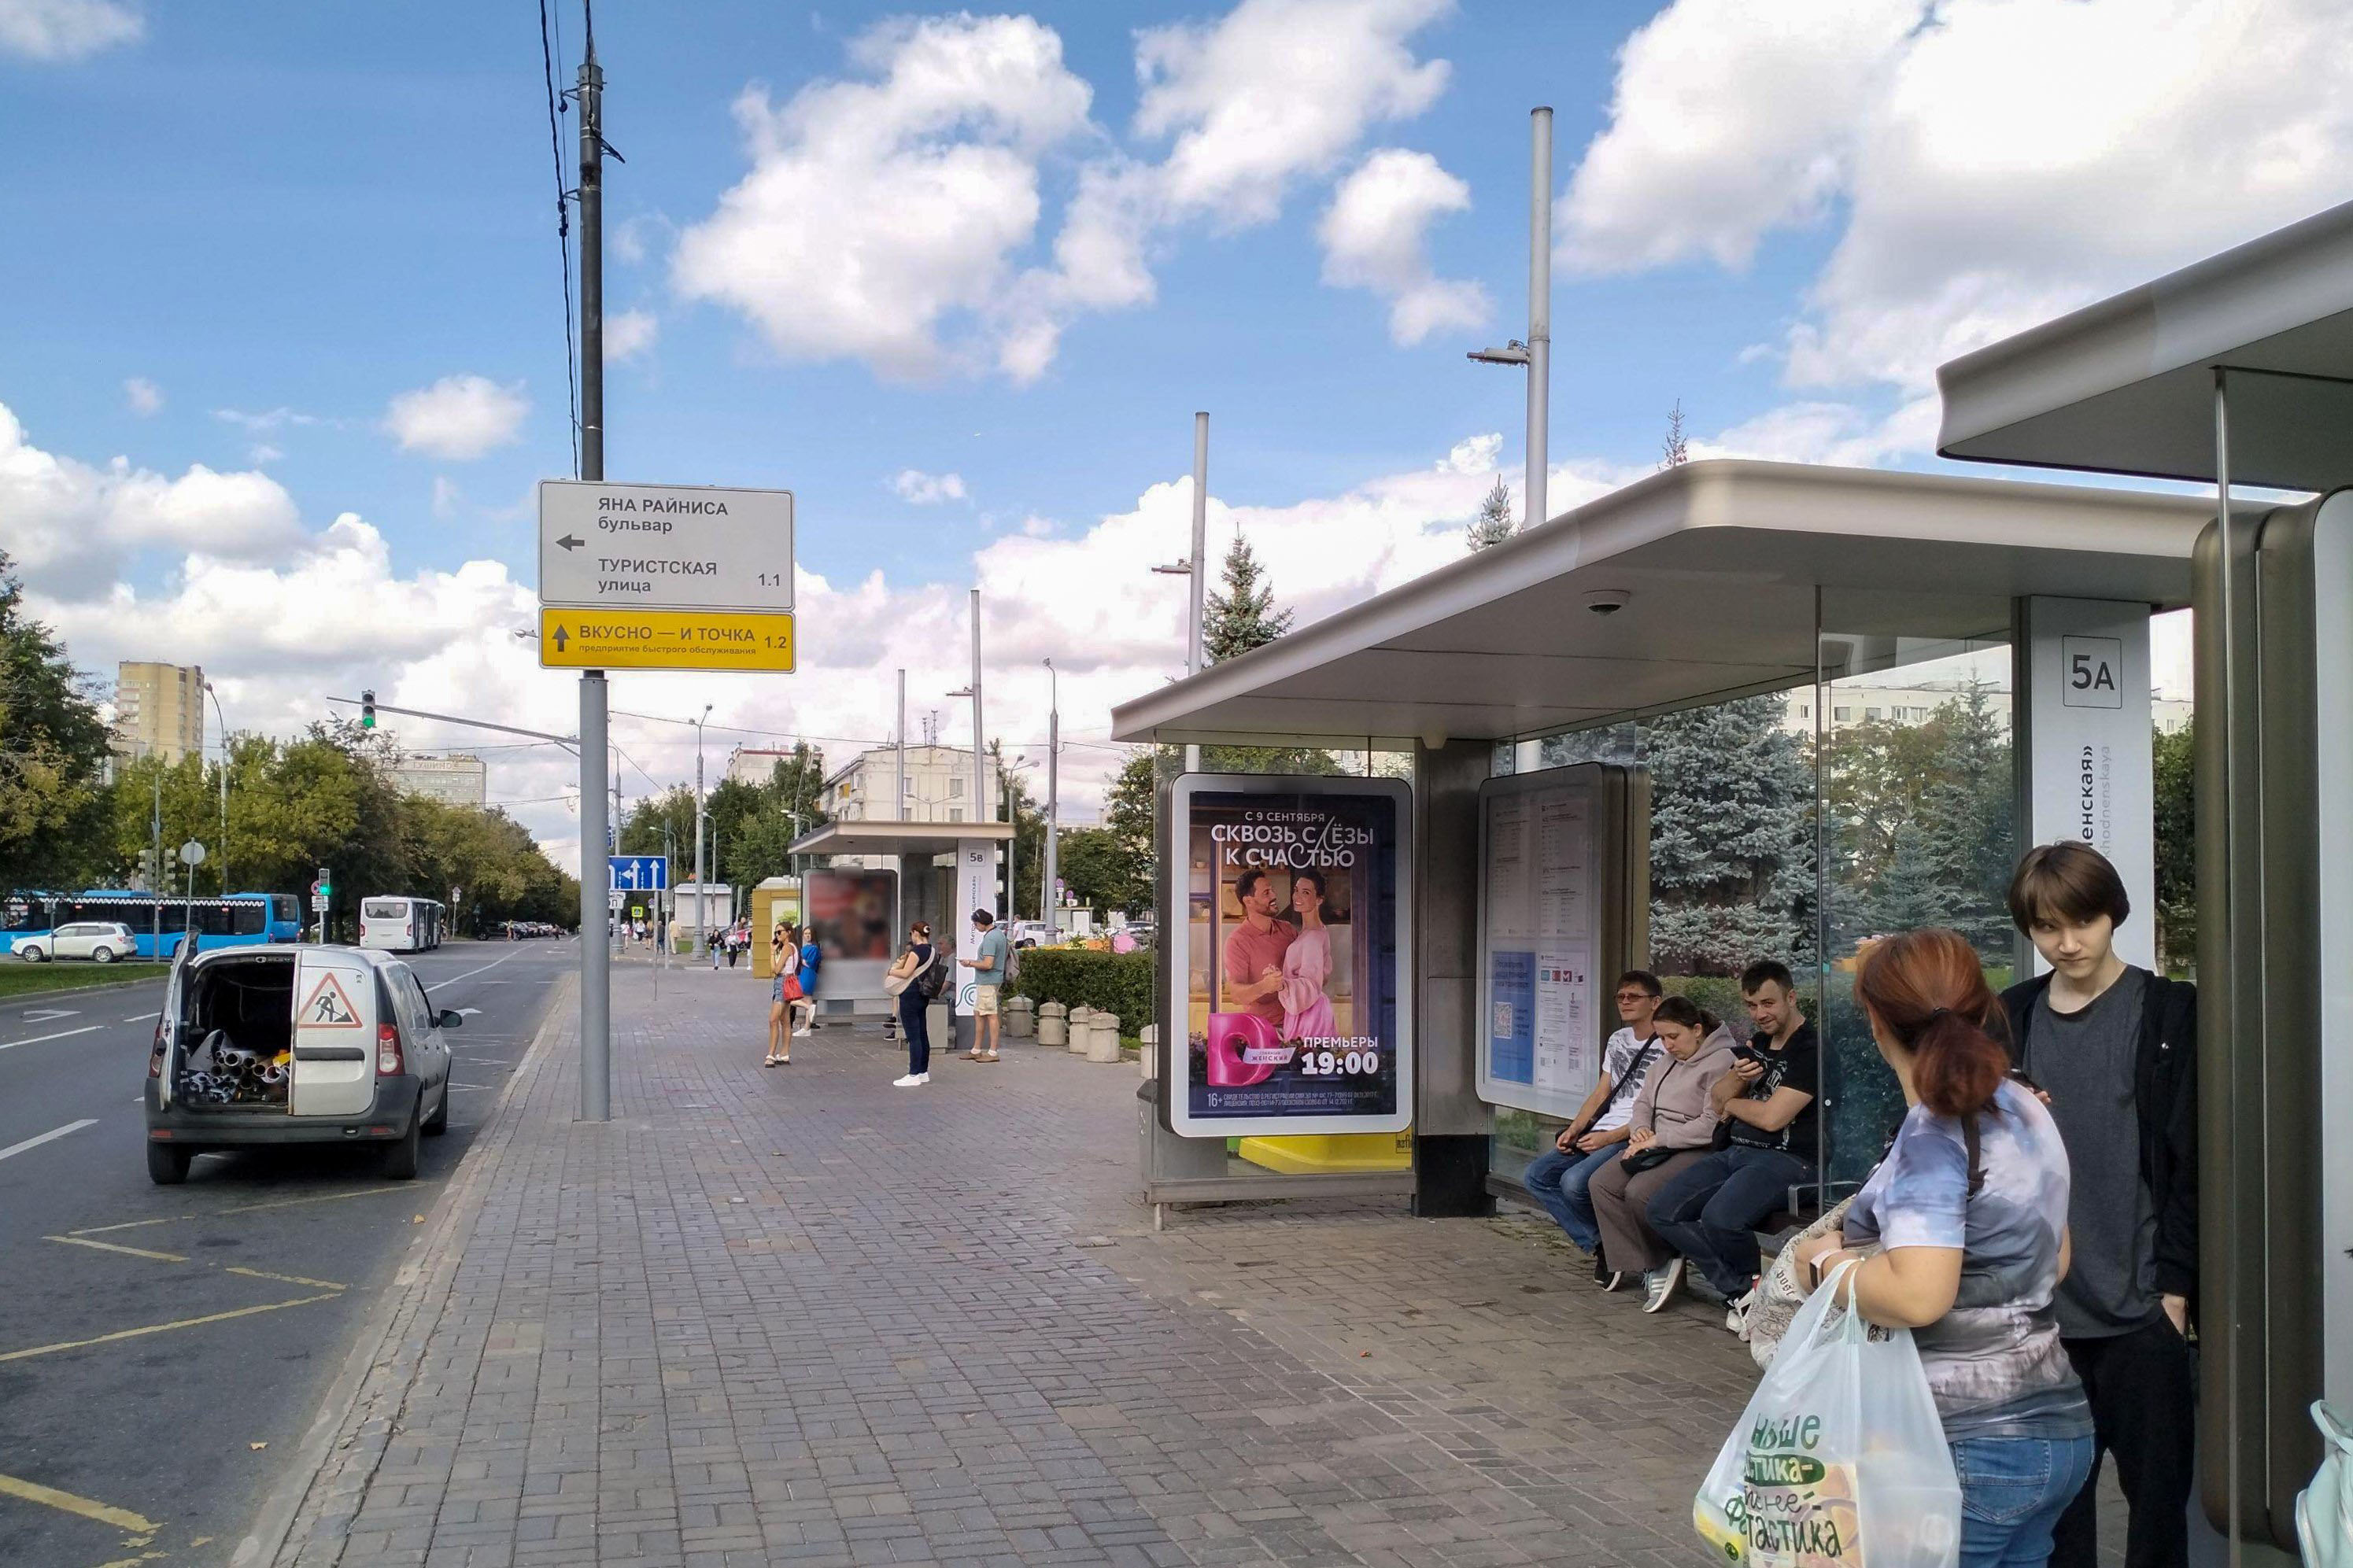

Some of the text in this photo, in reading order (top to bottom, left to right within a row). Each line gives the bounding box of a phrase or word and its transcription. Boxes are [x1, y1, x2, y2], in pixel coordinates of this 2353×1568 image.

[598, 497, 729, 516] ЯНА РАЙНИСА
[598, 516, 673, 534] бульвар
[598, 558, 717, 575] ТУРИСТСКАЯ
[598, 581, 651, 594] улица
[758, 574, 781, 587] 1.1
[579, 625, 652, 640] ВКУСНО
[681, 628, 692, 640] И
[697, 628, 755, 642] ТОЧКА
[579, 644, 756, 655] предприятие быстрого обслуживания
[764, 636, 787, 649] 1.2
[2100, 746, 2112, 858] khodnenskaya
[1245, 811, 1324, 822] С 9 СЕНТЯБРЯ
[1211, 816, 1373, 852] СКВОЗЬ СЛЁЗЫ
[1226, 843, 1355, 869] К СЧАСТЬЮ
[1303, 1036, 1378, 1048] ПРЕМЬЕРЫ
[1302, 1051, 1379, 1075] 19:00
[1207, 1093, 1223, 1107] 16+
